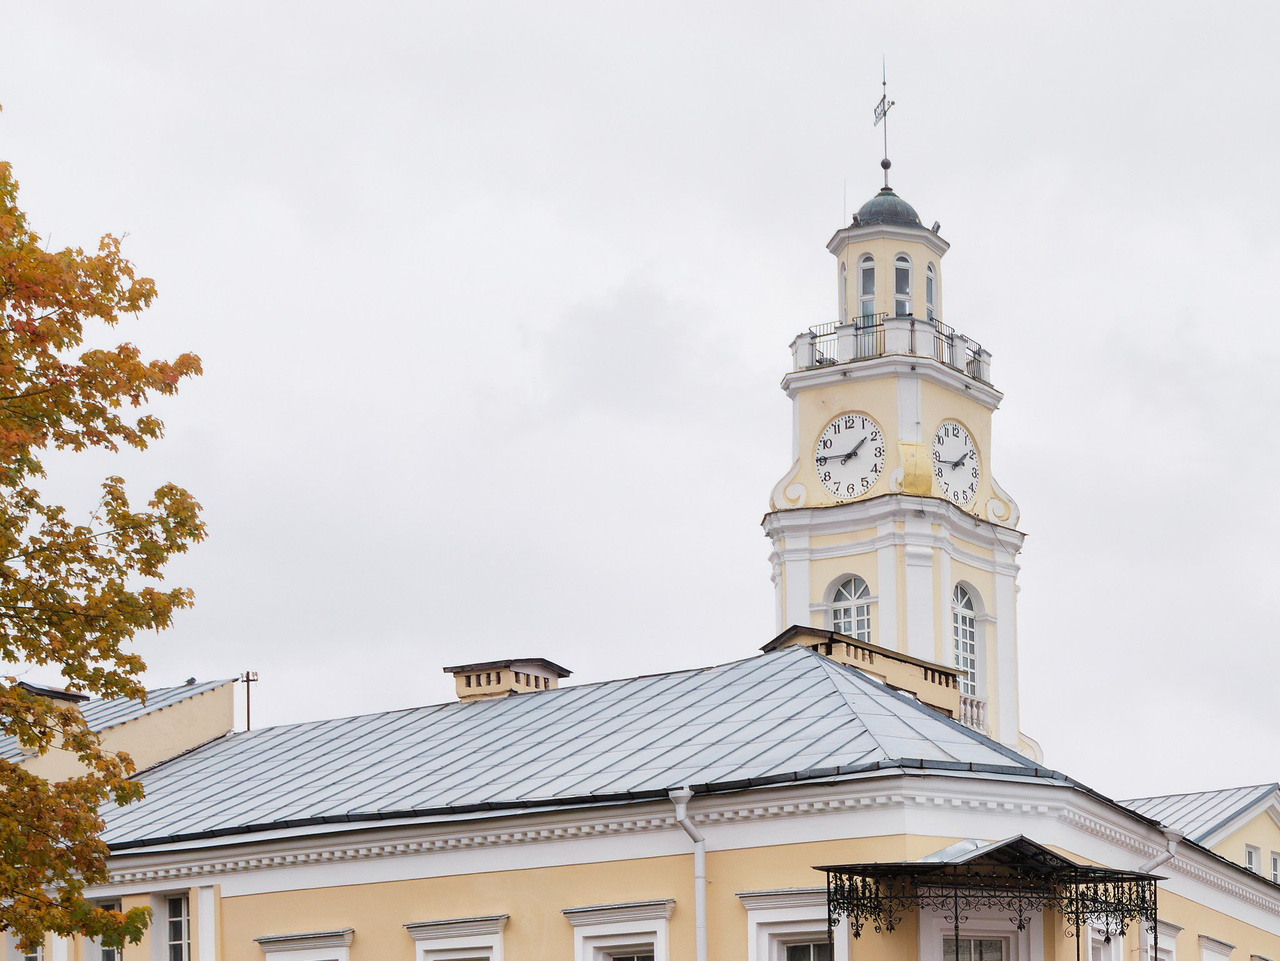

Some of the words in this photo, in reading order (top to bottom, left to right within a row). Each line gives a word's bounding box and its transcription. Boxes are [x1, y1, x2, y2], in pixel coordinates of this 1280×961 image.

[833, 423, 841, 435] 11
[845, 418, 855, 430] 12
[861, 418, 866, 430] 1
[870, 430, 878, 442] 2
[944, 427, 950, 438] 11
[952, 426, 960, 438] 12
[822, 438, 833, 450] 10
[937, 434, 944, 446] 10
[964, 435, 968, 446] 1
[874, 446, 882, 458] 3
[934, 450, 941, 461] 9
[968, 449, 976, 460] 2
[870, 463, 879, 474] 4
[937, 467, 943, 478] 8
[971, 467, 978, 479] 3
[823, 471, 832, 482] 8
[860, 476, 869, 488] 5
[833, 481, 841, 492] 7
[846, 483, 855, 494] 6
[943, 481, 950, 493] 7
[968, 482, 974, 493] 4
[953, 490, 960, 502] 6
[962, 489, 969, 501] 5
